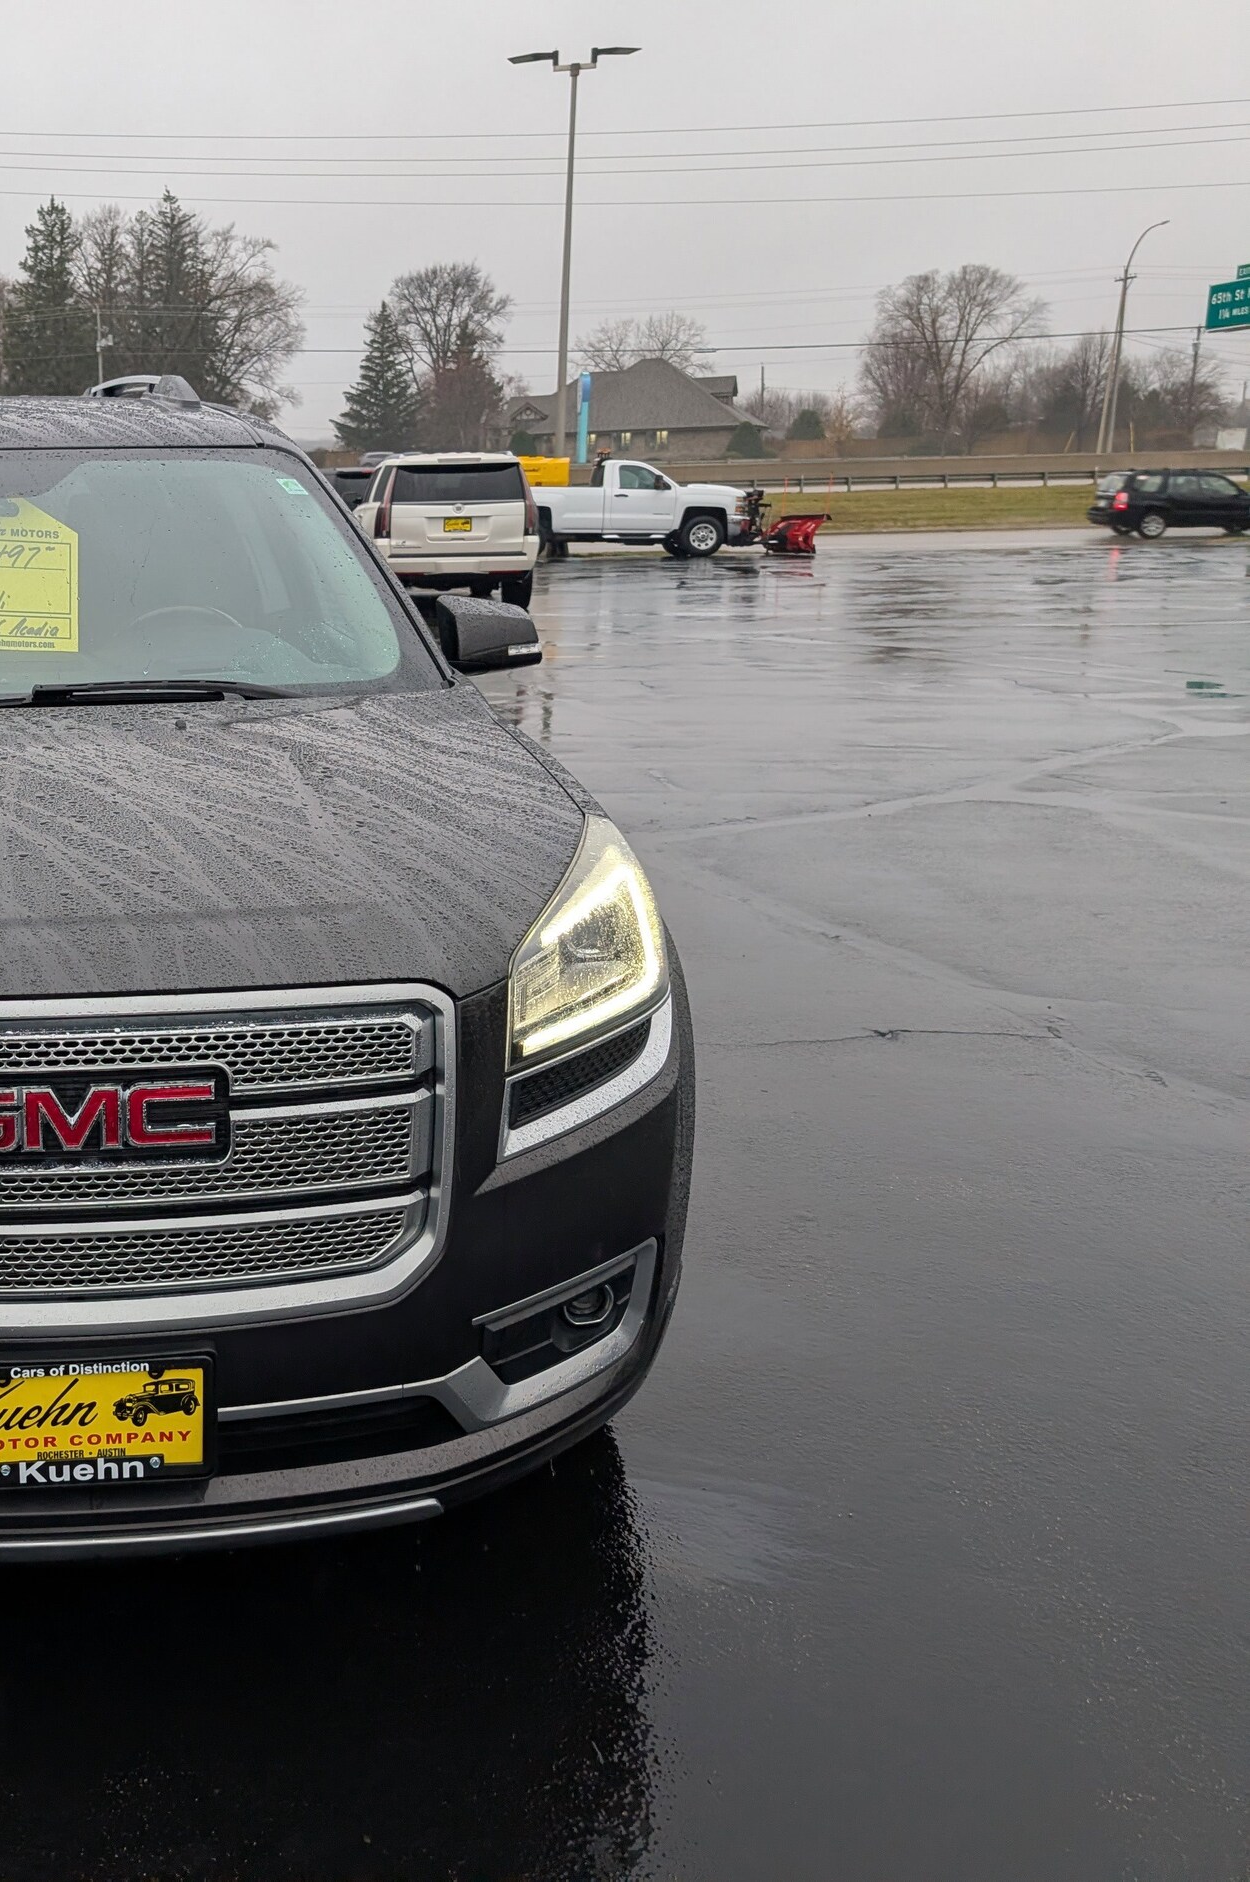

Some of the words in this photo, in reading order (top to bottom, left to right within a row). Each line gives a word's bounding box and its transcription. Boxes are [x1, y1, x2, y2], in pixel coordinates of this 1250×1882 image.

[1211, 291, 1232, 305] 65th
[1234, 289, 1245, 301] St
[11, 528, 60, 539] MOTORS
[9, 617, 59, 637] Acadia
[10, 1366, 48, 1380] Cars
[50, 1364, 66, 1377] of
[69, 1361, 150, 1376] Distinction
[69, 1430, 192, 1447] COMPANY
[36, 1449, 85, 1460] ROCHESTER
[96, 1447, 126, 1458] AUSTIN
[19, 1459, 145, 1484] Kuehn
